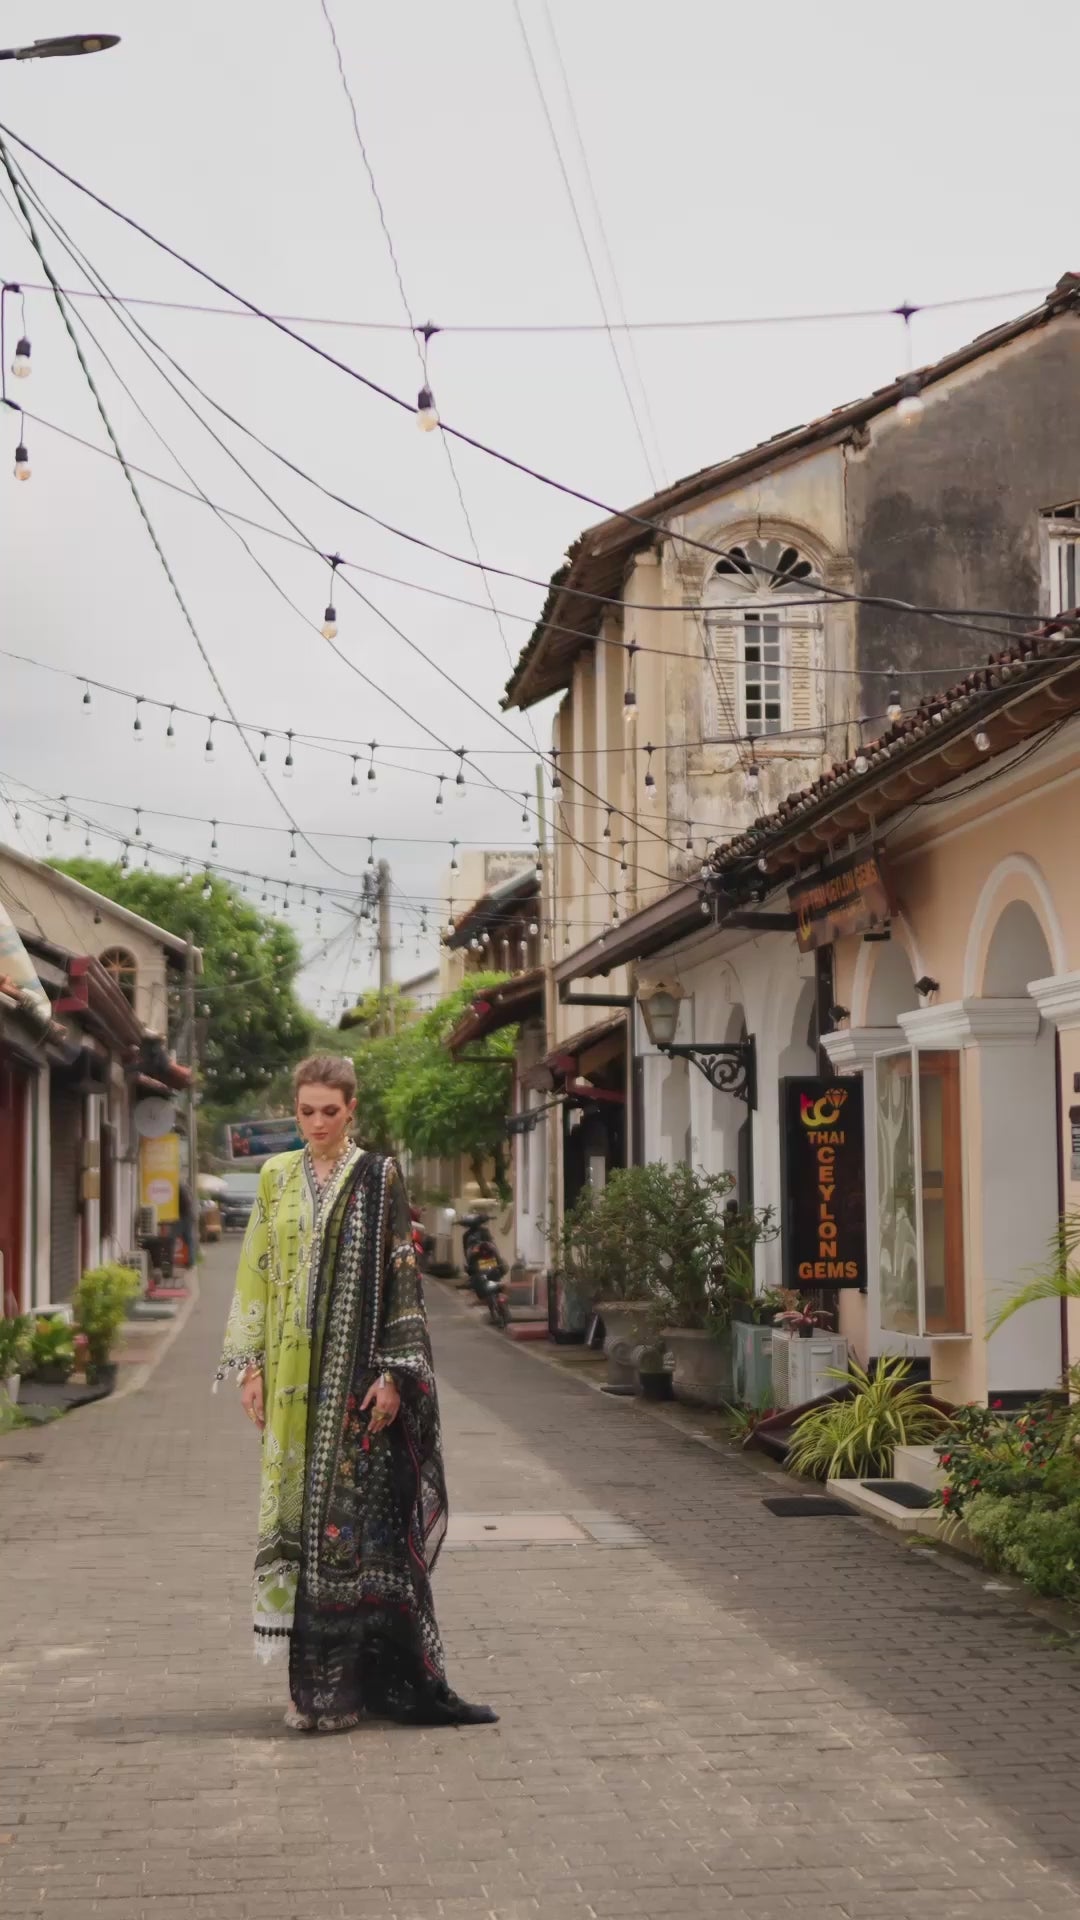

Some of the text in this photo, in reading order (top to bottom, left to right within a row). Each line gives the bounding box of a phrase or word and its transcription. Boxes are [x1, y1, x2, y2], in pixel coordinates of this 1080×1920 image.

[807, 1131, 846, 1144] THAI
[817, 1146, 837, 1258] CEYLON
[798, 1261, 858, 1279] GEMS
